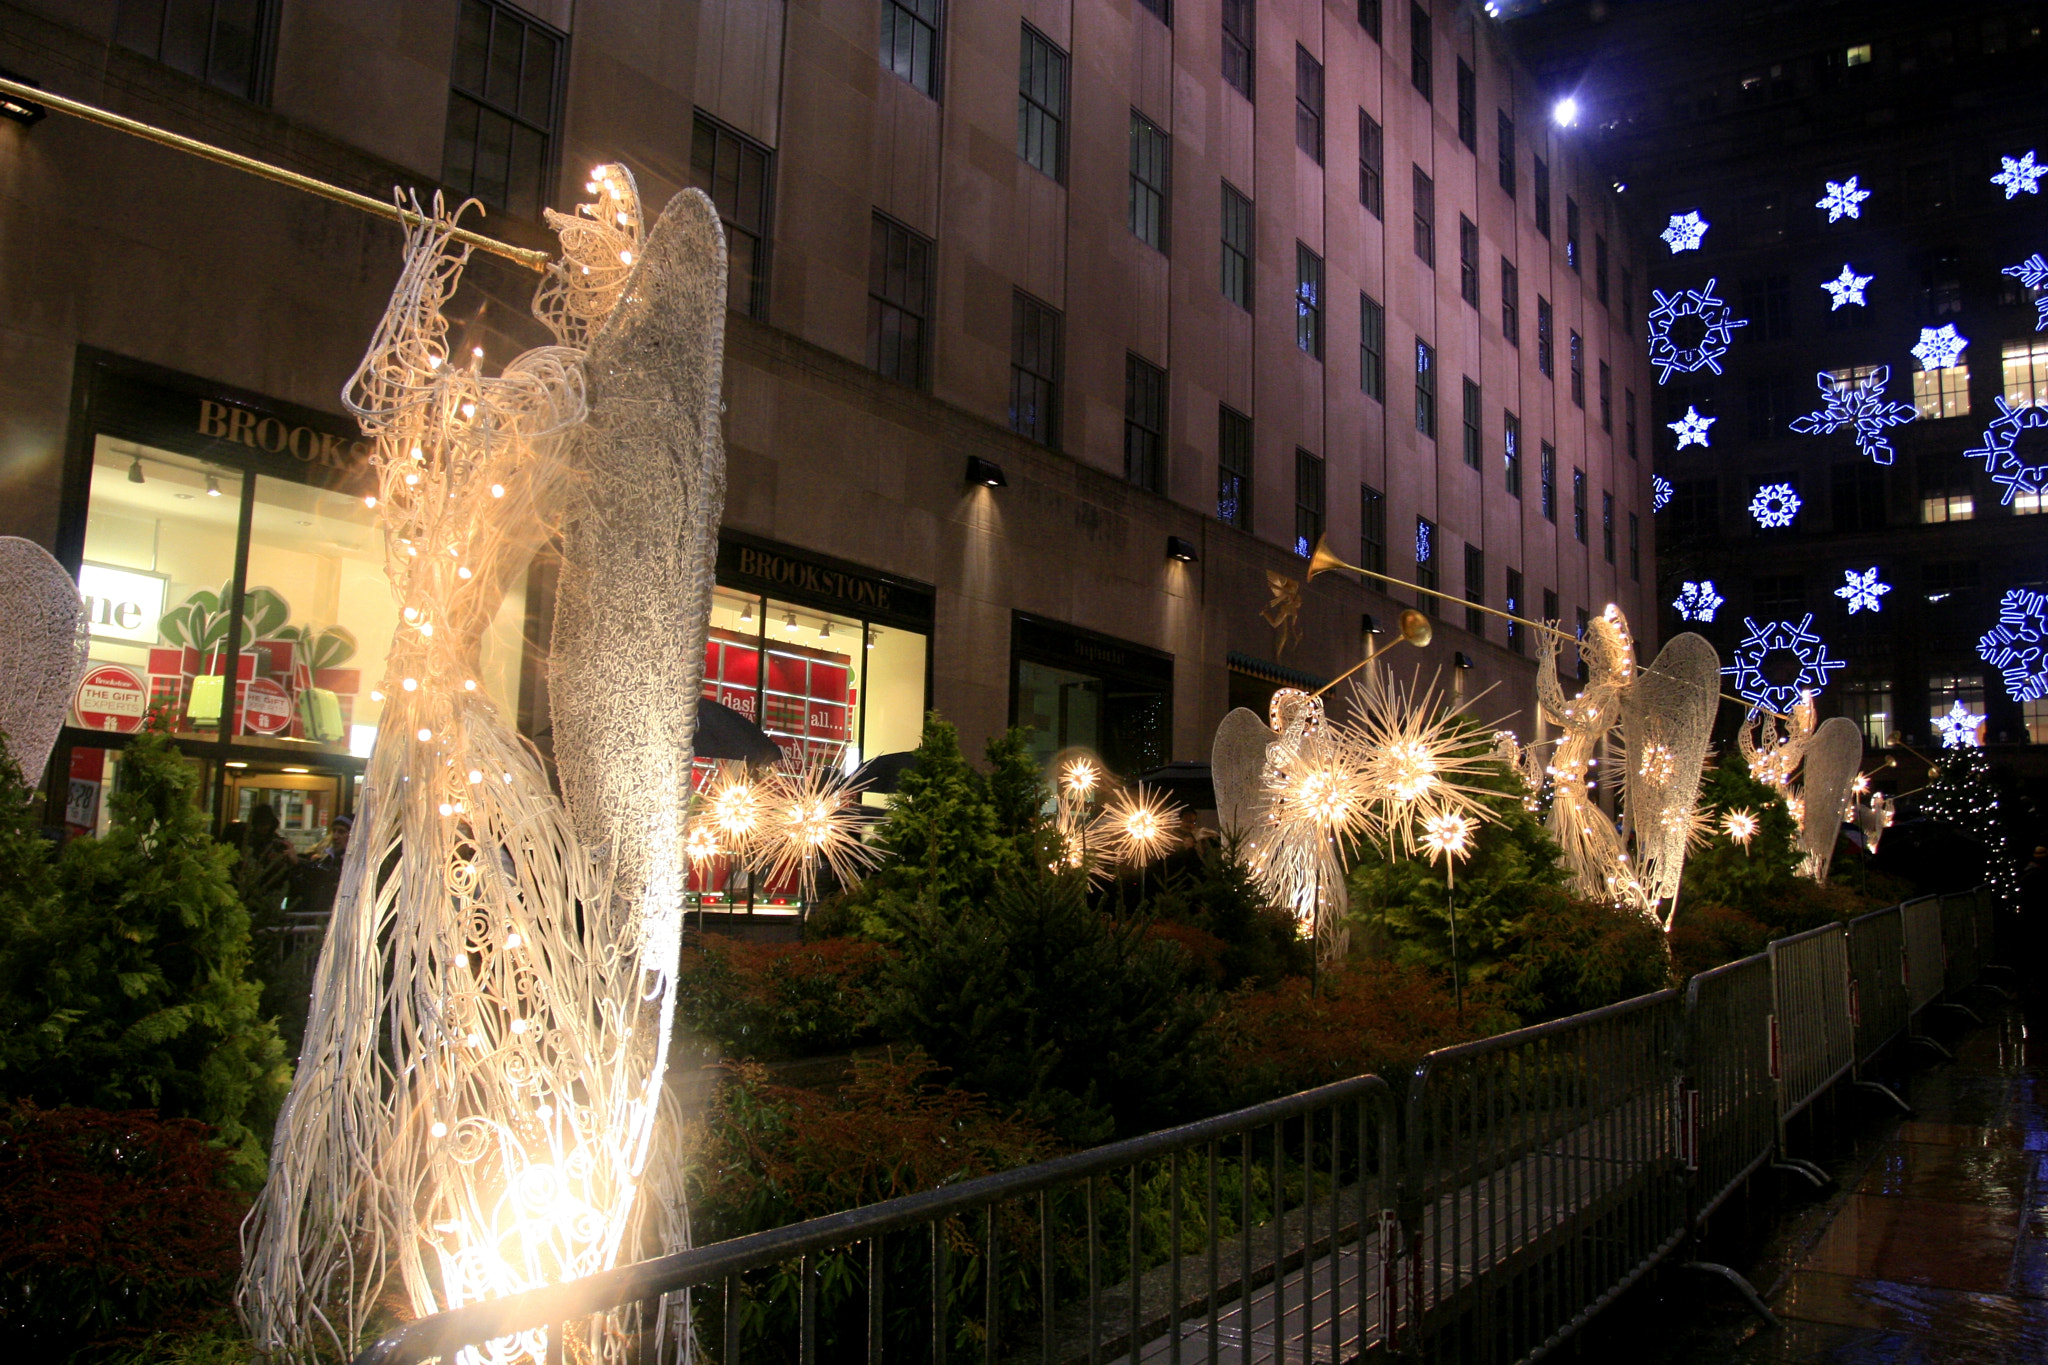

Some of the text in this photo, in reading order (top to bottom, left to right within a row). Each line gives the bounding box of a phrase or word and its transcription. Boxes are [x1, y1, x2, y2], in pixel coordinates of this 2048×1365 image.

[197, 399, 369, 478] BROOKS
[739, 547, 891, 610] BROOKSTONE
[82, 594, 142, 630] ne
[84, 698, 140, 712] EXPERTS
[85, 689, 140, 702] THE GIFT
